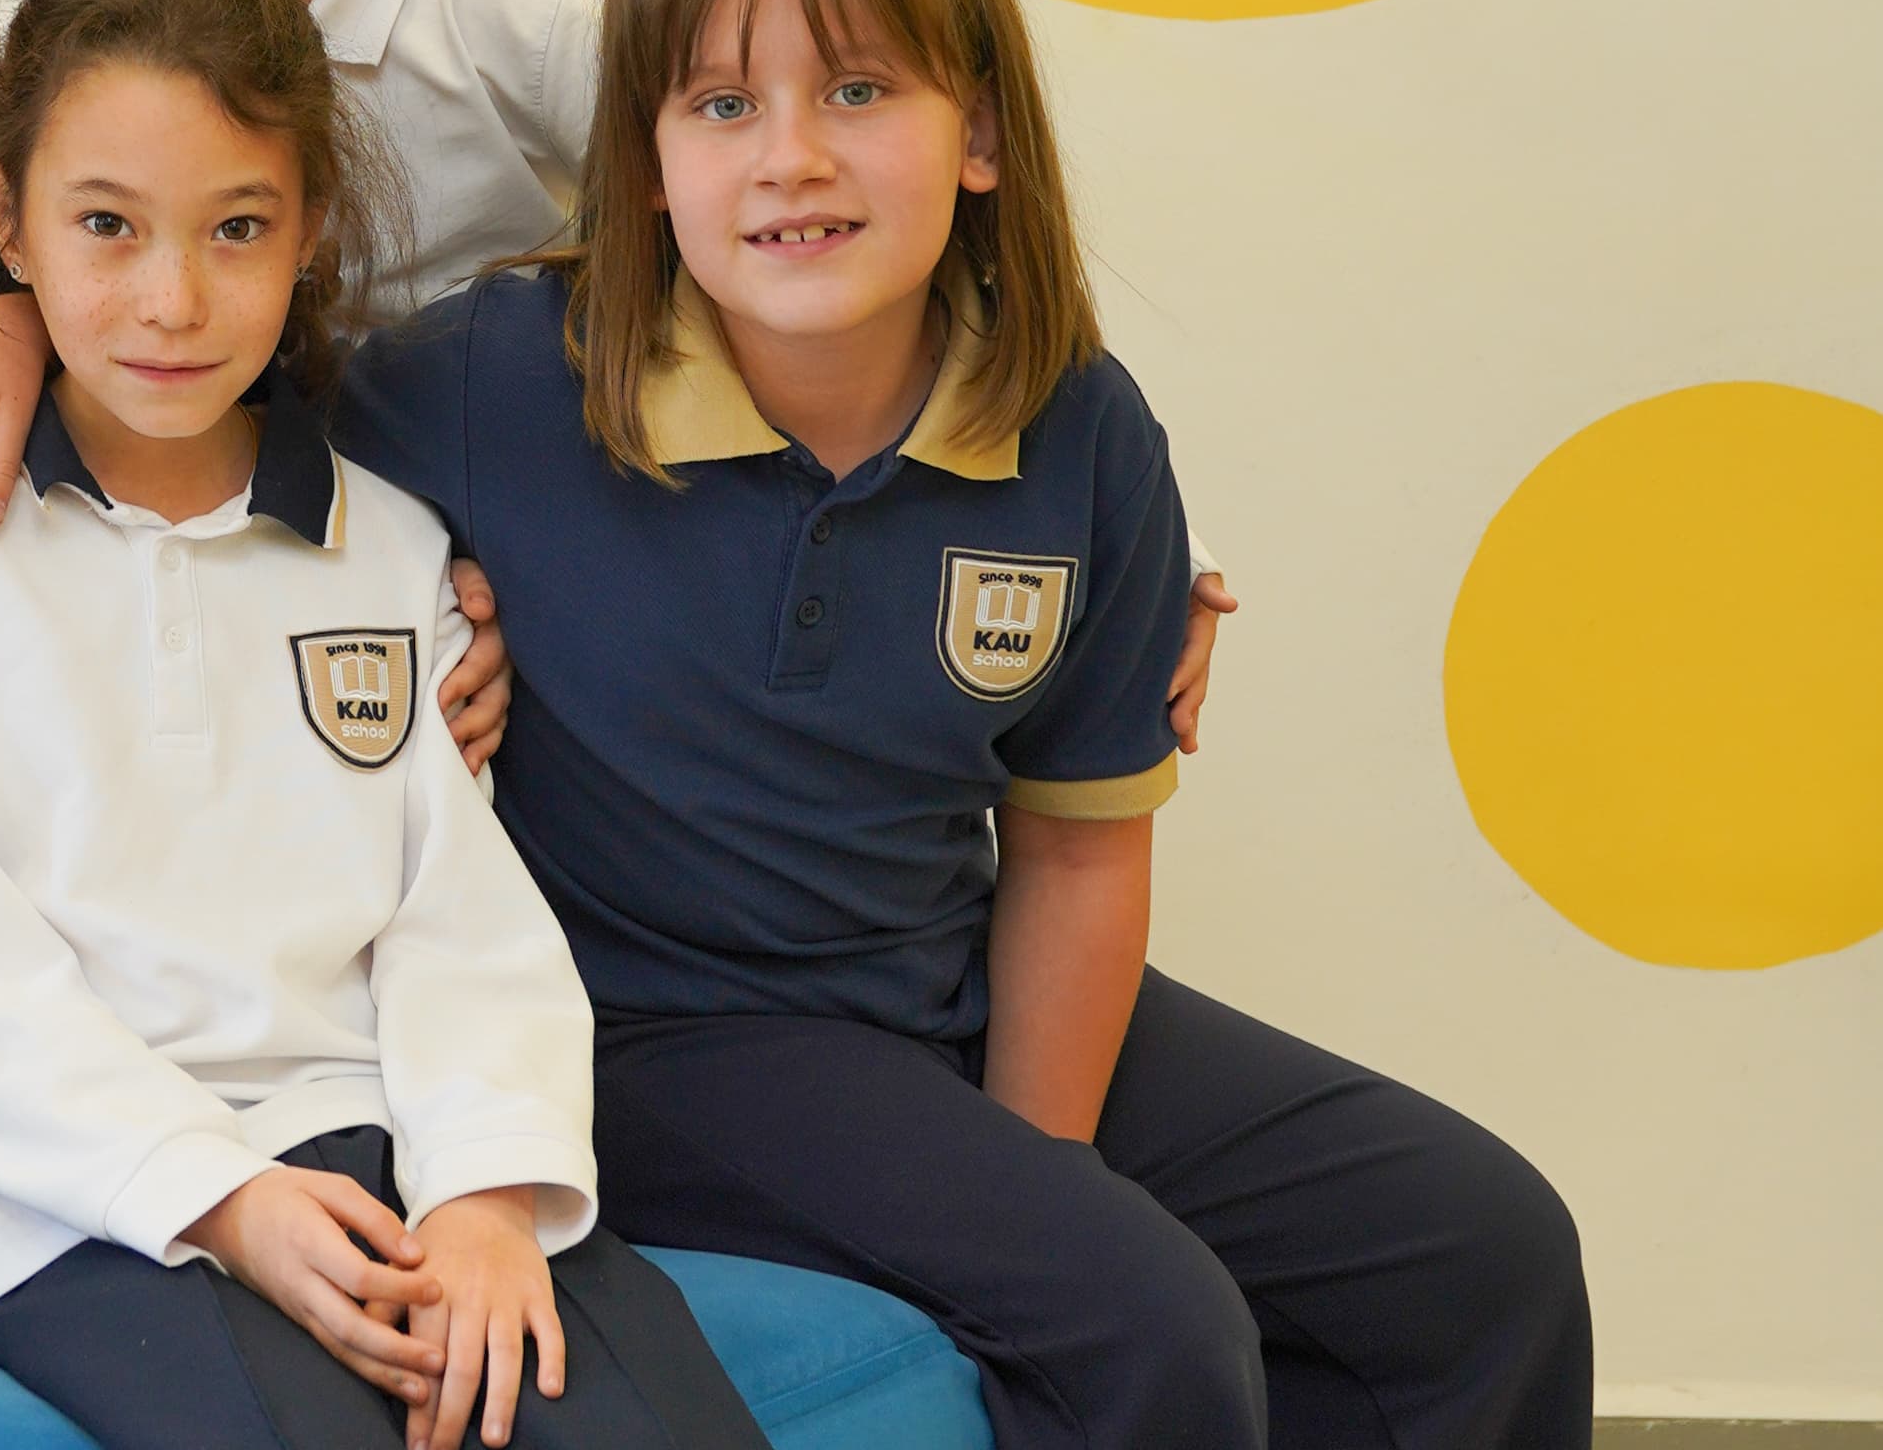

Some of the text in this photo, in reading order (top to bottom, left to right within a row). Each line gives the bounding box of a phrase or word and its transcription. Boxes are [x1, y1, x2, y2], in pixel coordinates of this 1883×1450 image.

[978, 572, 1014, 585] since
[325, 642, 360, 657] since
[973, 630, 1032, 653] KAU
[972, 651, 1029, 669] school
[336, 700, 388, 722] KAU
[340, 723, 391, 740] school
